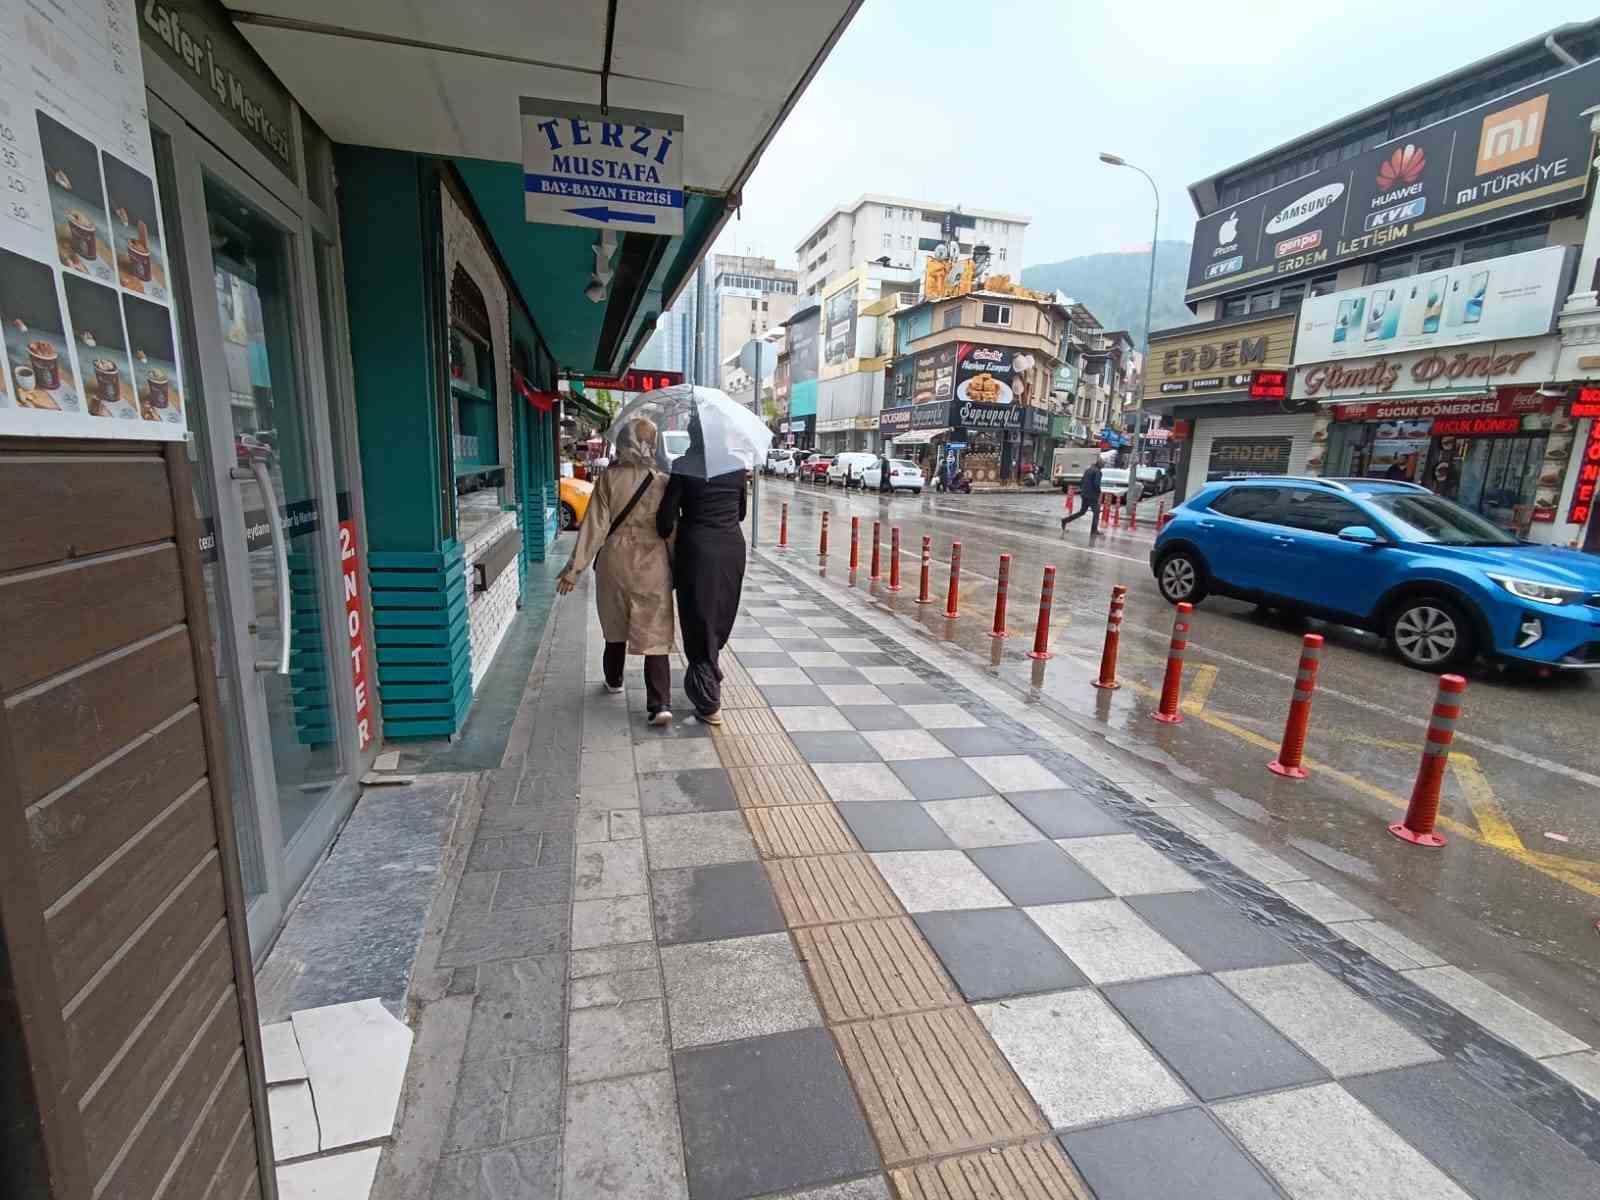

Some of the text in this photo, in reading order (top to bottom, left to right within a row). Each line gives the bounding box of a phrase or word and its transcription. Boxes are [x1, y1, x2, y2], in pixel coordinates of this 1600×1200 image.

[144, 0, 204, 75] Zafer
[228, 72, 289, 162] Merkezi
[537, 117, 673, 165] TERZİ
[552, 154, 661, 184] MUSTAFA
[1480, 158, 1569, 197] TÜRKİYE
[541, 180, 673, 205] BAY-BAYAN TERZİSİ
[1371, 182, 1423, 208] HUAWEI
[1274, 194, 1334, 223] SAMSUNG
[1372, 202, 1417, 227] KVK
[1278, 224, 1409, 273] ERDEM İLETİŞİM
[1163, 335, 1267, 375] ERDEM
[1304, 358, 1402, 397] Gümüş
[1410, 350, 1537, 383] Döner
[1376, 406, 1419, 418] SUCUK
[1421, 402, 1500, 416] DÖNERCİSİ
[1474, 419, 1518, 432] DÖNER
[1218, 445, 1281, 460] ERDEM
[344, 571, 370, 750] NOTER
